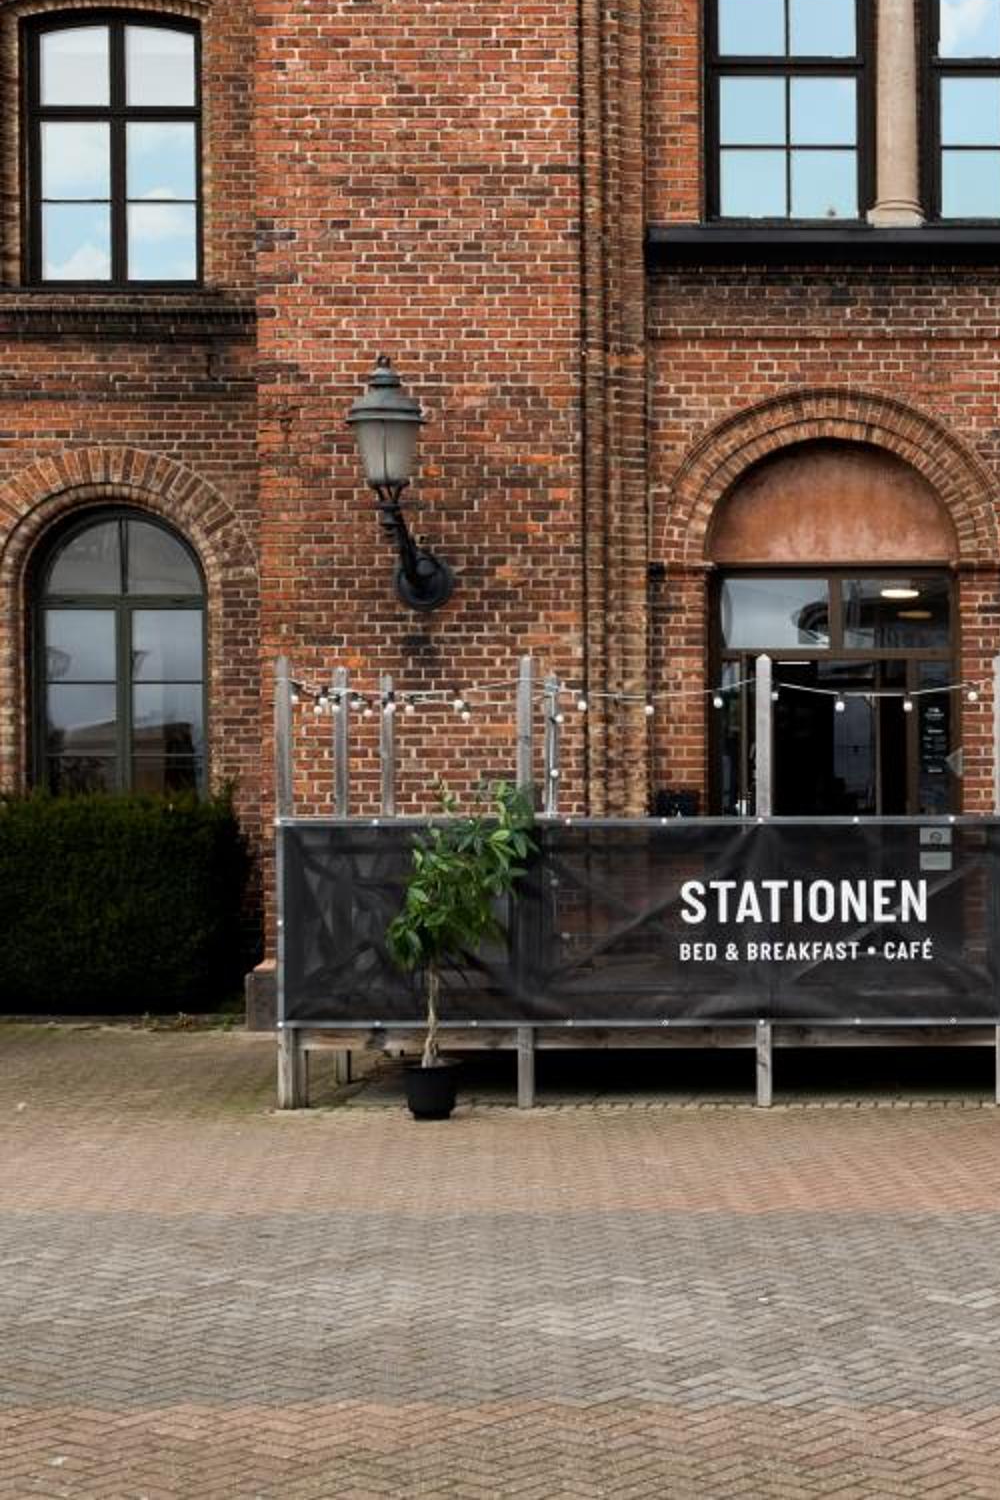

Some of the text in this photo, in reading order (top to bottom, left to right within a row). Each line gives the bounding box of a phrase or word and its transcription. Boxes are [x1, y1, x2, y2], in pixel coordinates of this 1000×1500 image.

[679, 879, 928, 924] STATIONEN
[679, 937, 933, 961] BED & BREAKFAST CAFÉ
